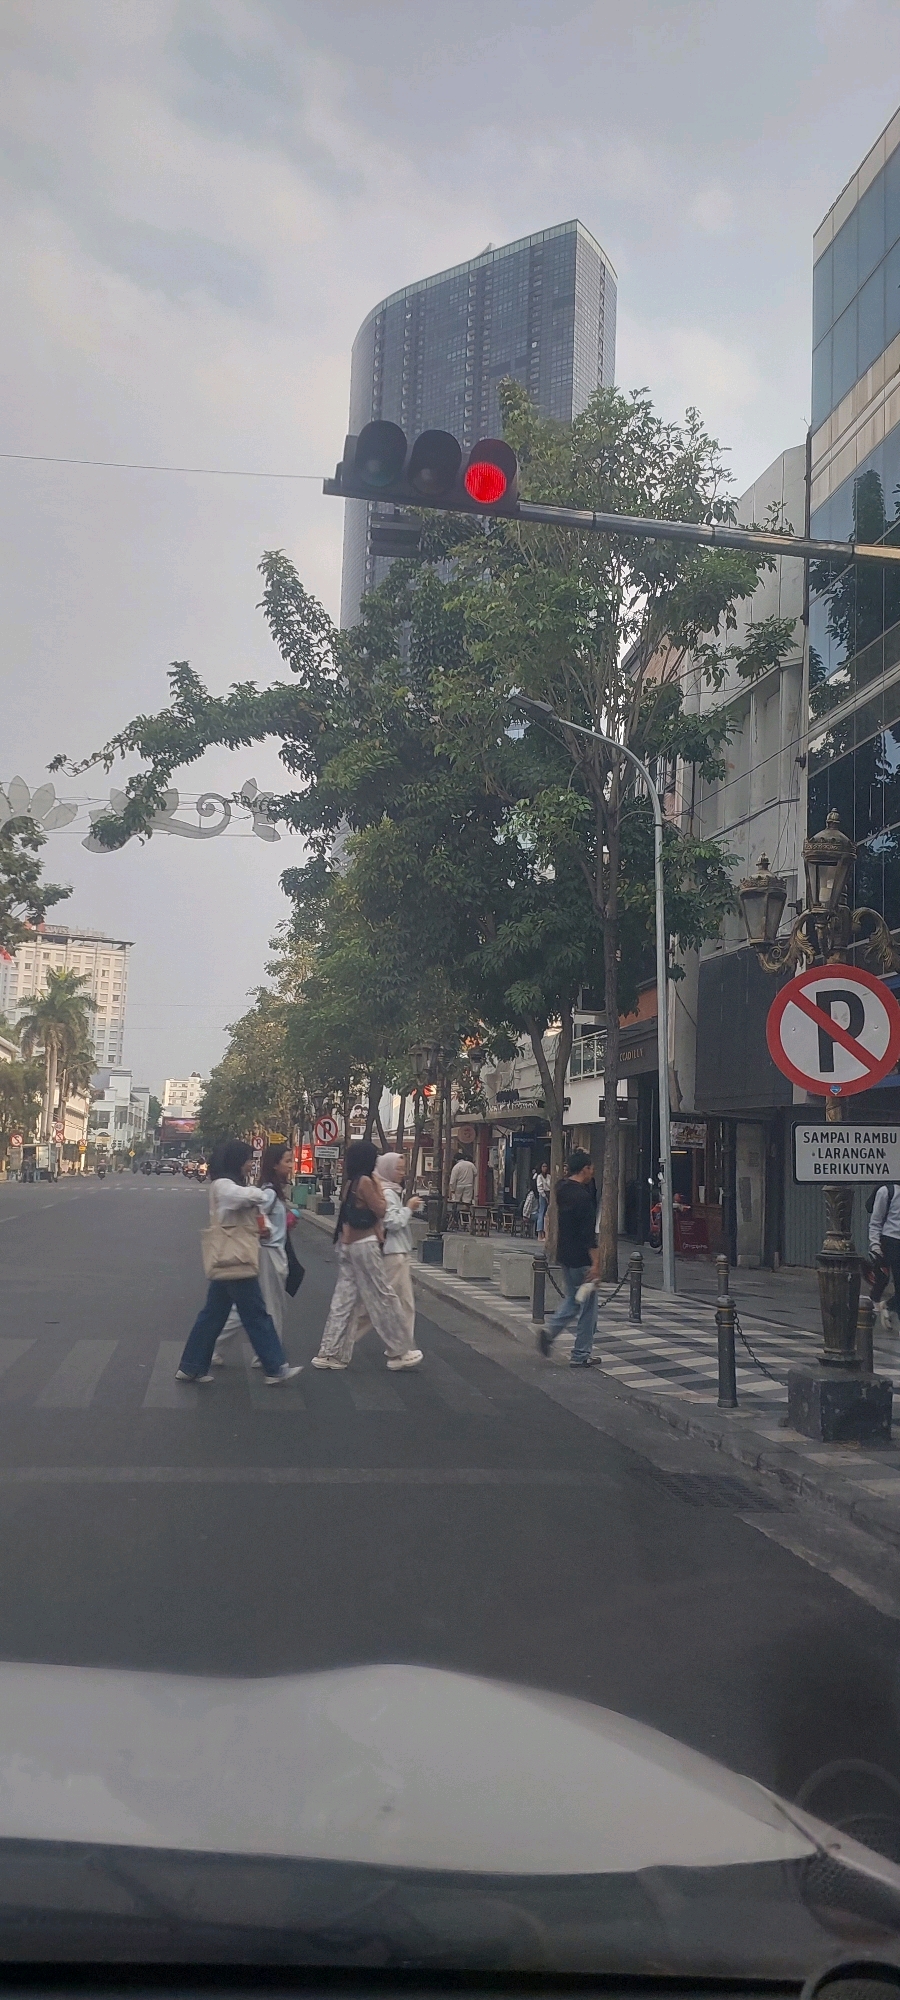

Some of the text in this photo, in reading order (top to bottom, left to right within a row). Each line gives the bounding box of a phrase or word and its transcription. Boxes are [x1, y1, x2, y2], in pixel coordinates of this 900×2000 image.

[816, 989, 865, 1073] P
[803, 1131, 897, 1144] SAMPAI RAMBU
[818, 1147, 884, 1159] LARANGAN
[814, 1162, 890, 1175] BERIKUTNYA
